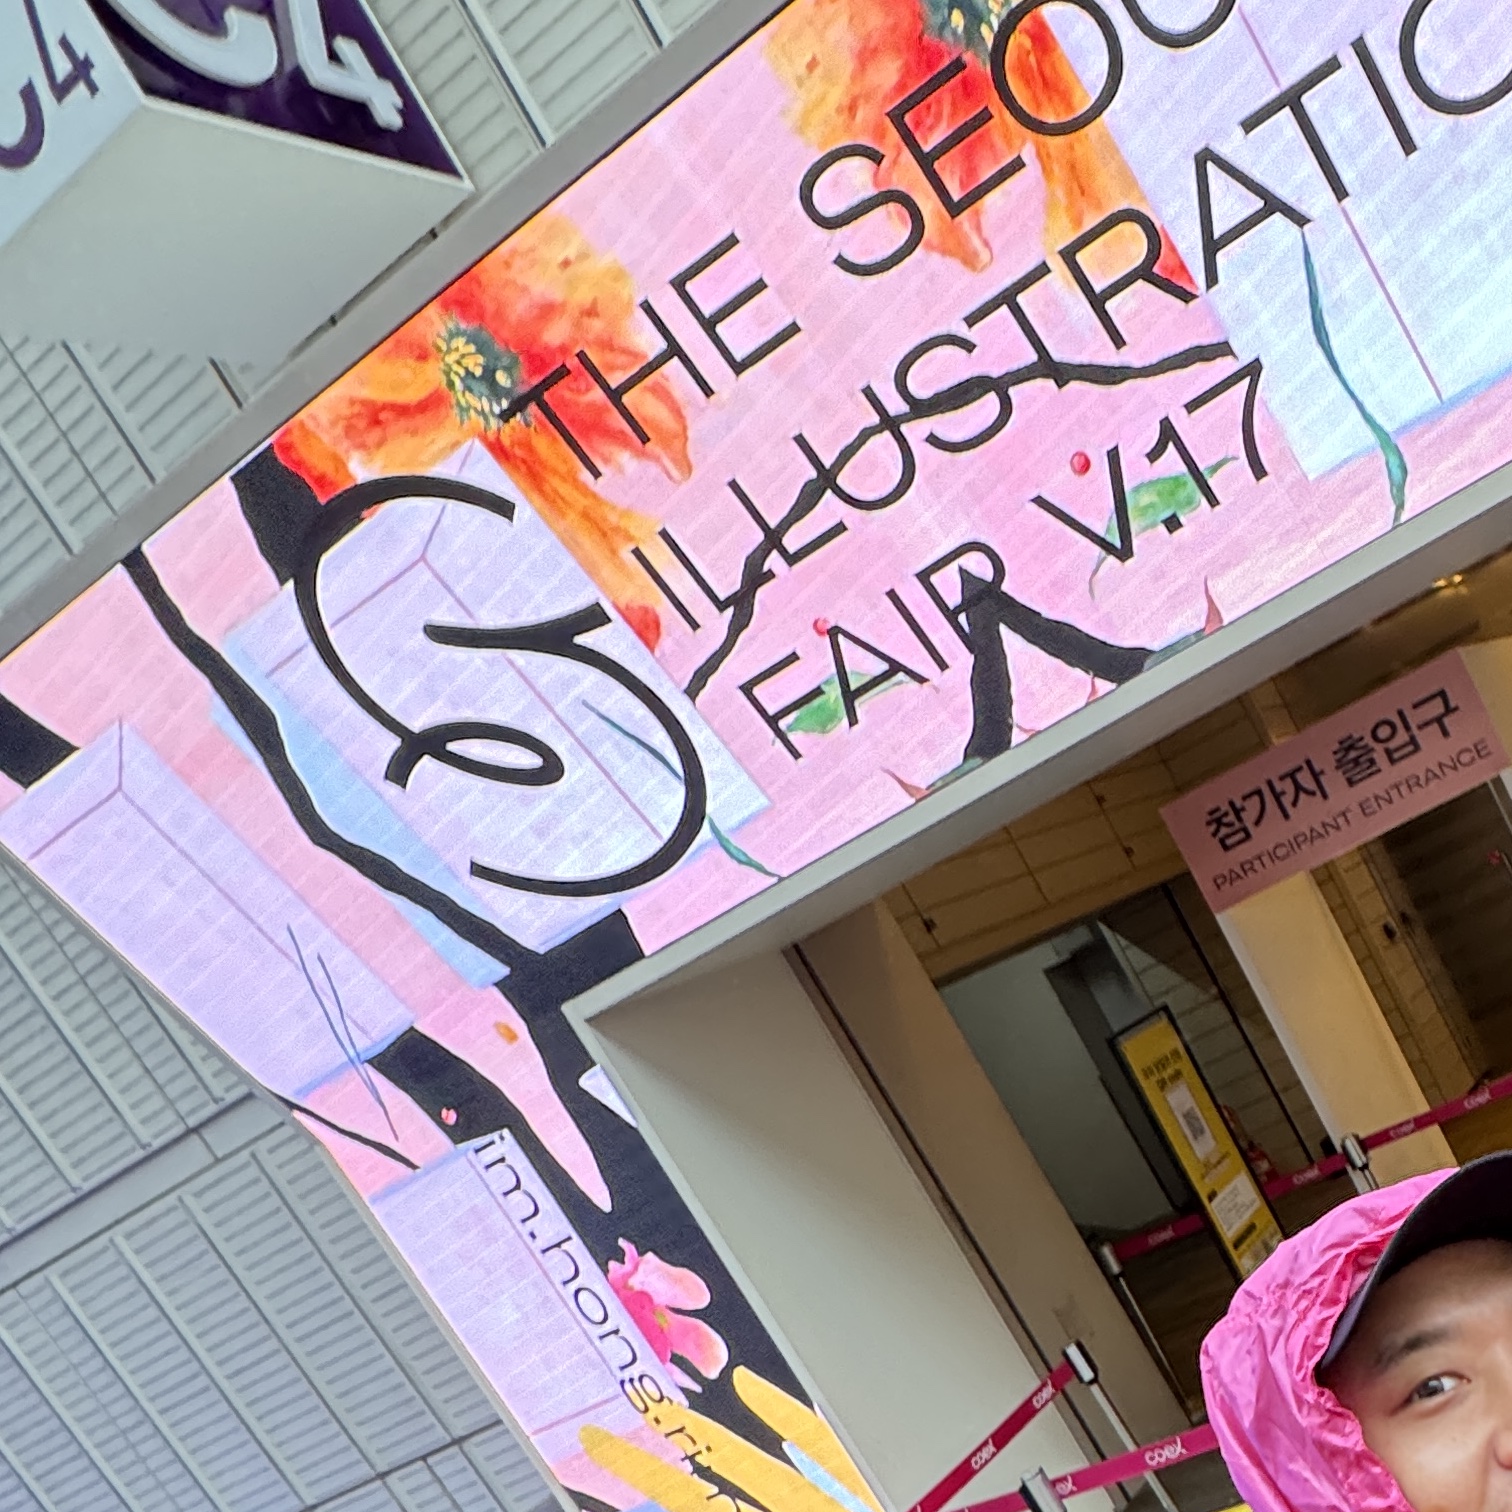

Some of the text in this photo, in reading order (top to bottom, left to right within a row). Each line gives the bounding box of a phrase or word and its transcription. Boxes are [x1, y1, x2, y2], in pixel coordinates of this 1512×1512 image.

[498, 231, 802, 480] THE
[738, 359, 1271, 762] FAIR V.17
[1204, 687, 1461, 853] 참가자 출입구
[1211, 738, 1493, 891] PARTICIPANT ENTRANCE
[971, 1439, 998, 1470] coex
[1055, 1475, 1078, 1496] ex
[1145, 1436, 1188, 1467] coex
